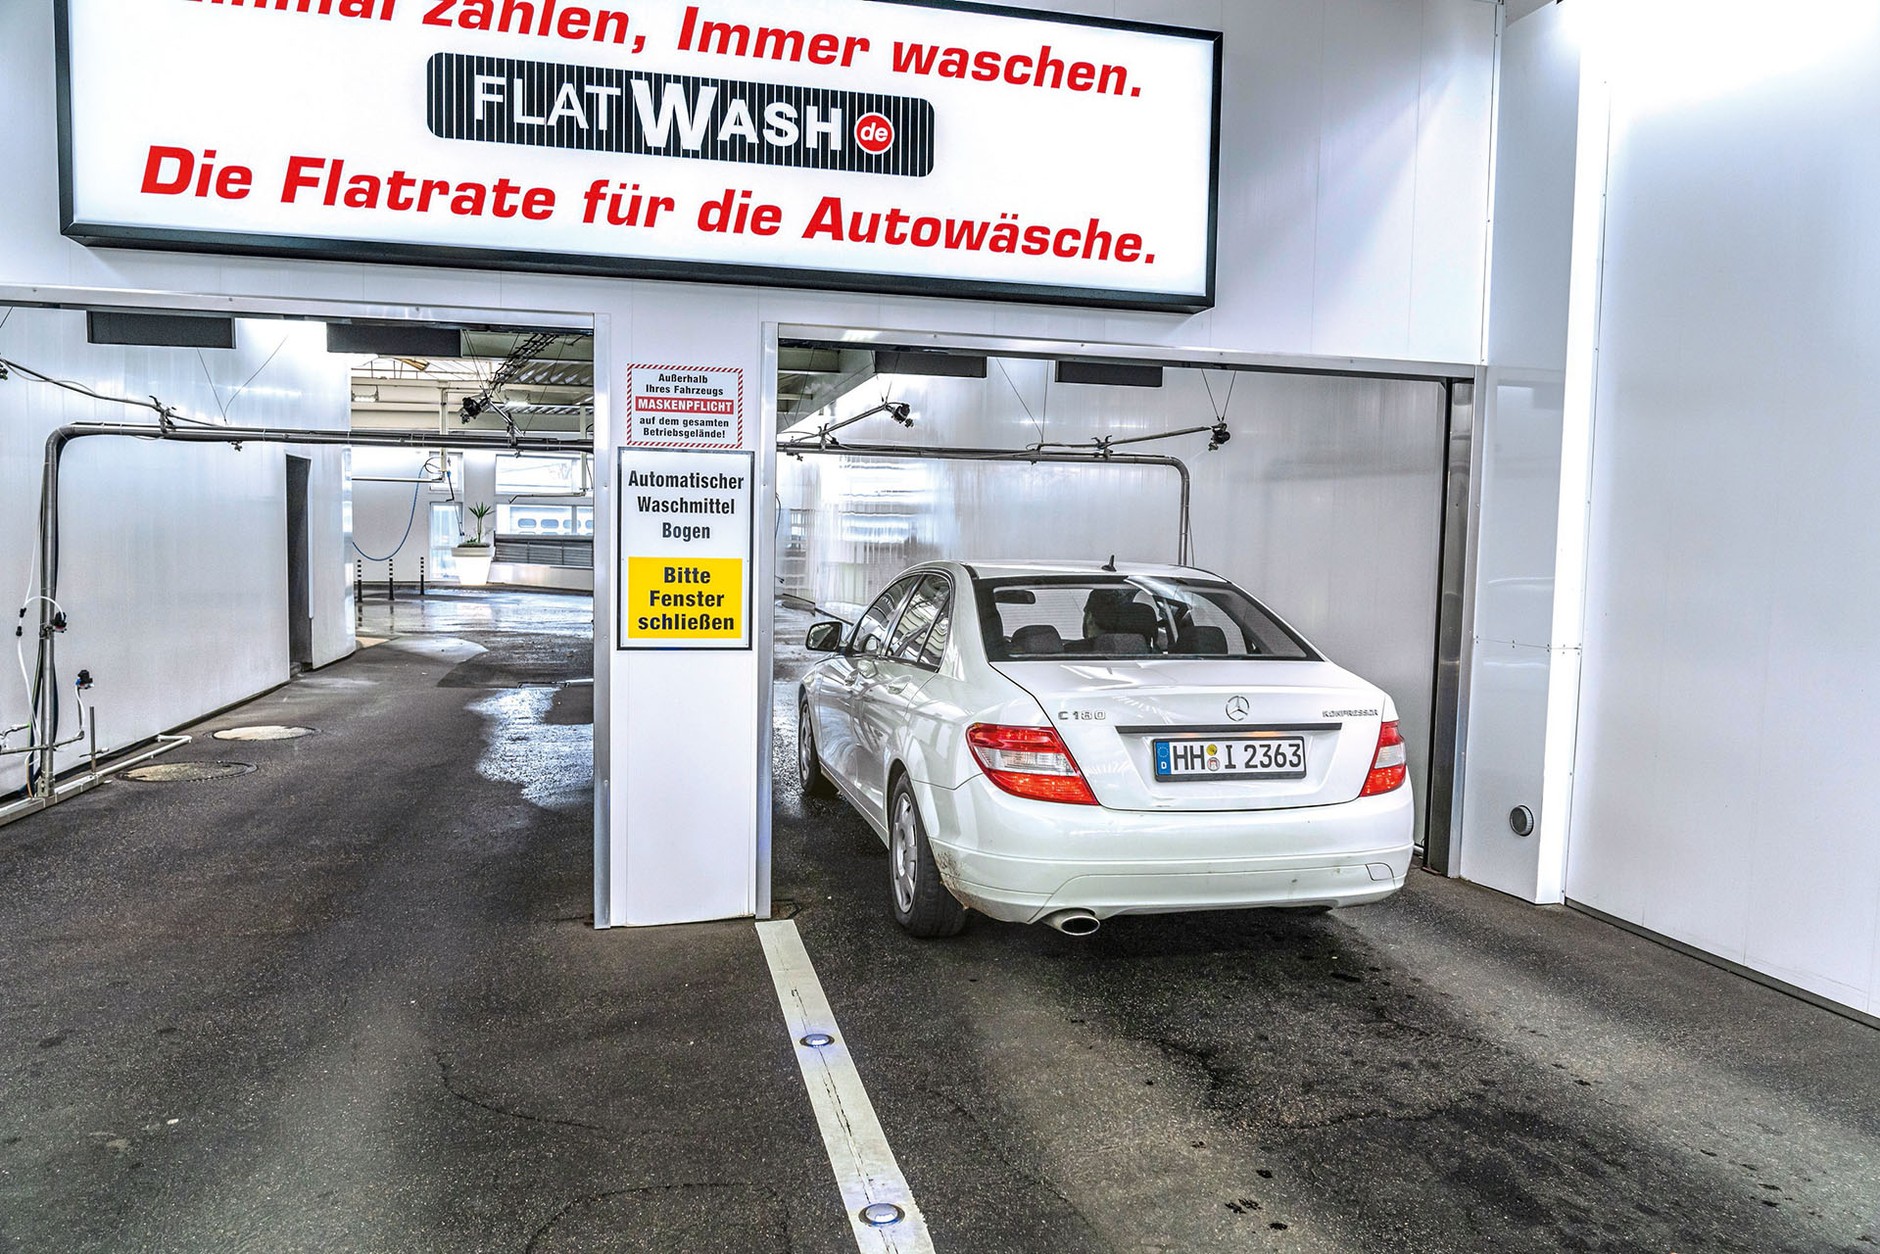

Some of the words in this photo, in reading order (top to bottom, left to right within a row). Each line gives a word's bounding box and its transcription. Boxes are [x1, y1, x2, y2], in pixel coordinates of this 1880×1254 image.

[677, 6, 869, 67] Immer
[892, 41, 1141, 97] waschen.
[140, 145, 253, 200] Die
[280, 155, 556, 221] Flatrate
[583, 179, 675, 228] für
[697, 188, 782, 237] die
[802, 196, 1155, 265] Autowäsche.
[658, 373, 708, 384] Außerhalb
[645, 384, 671, 394] Ihres
[674, 385, 724, 397] Fahrzeugs
[638, 398, 732, 412] MASKENPFLICHT
[639, 416, 656, 425] auf
[658, 417, 679, 425] dem
[682, 419, 729, 428] gesamten
[643, 427, 726, 439] Betriebsgelände!
[628, 470, 744, 490] Automatischer
[637, 495, 735, 515] Waschmittel
[662, 522, 710, 542] Bogen
[664, 566, 711, 584] Bitte
[649, 590, 724, 607] Fenster
[638, 613, 734, 630] schließen
[1058, 711, 1069, 720] C
[1160, 761, 1167, 769] D
[1172, 745, 1206, 770] HH
[1224, 744, 1237, 769] I
[1243, 743, 1301, 769] 2363
